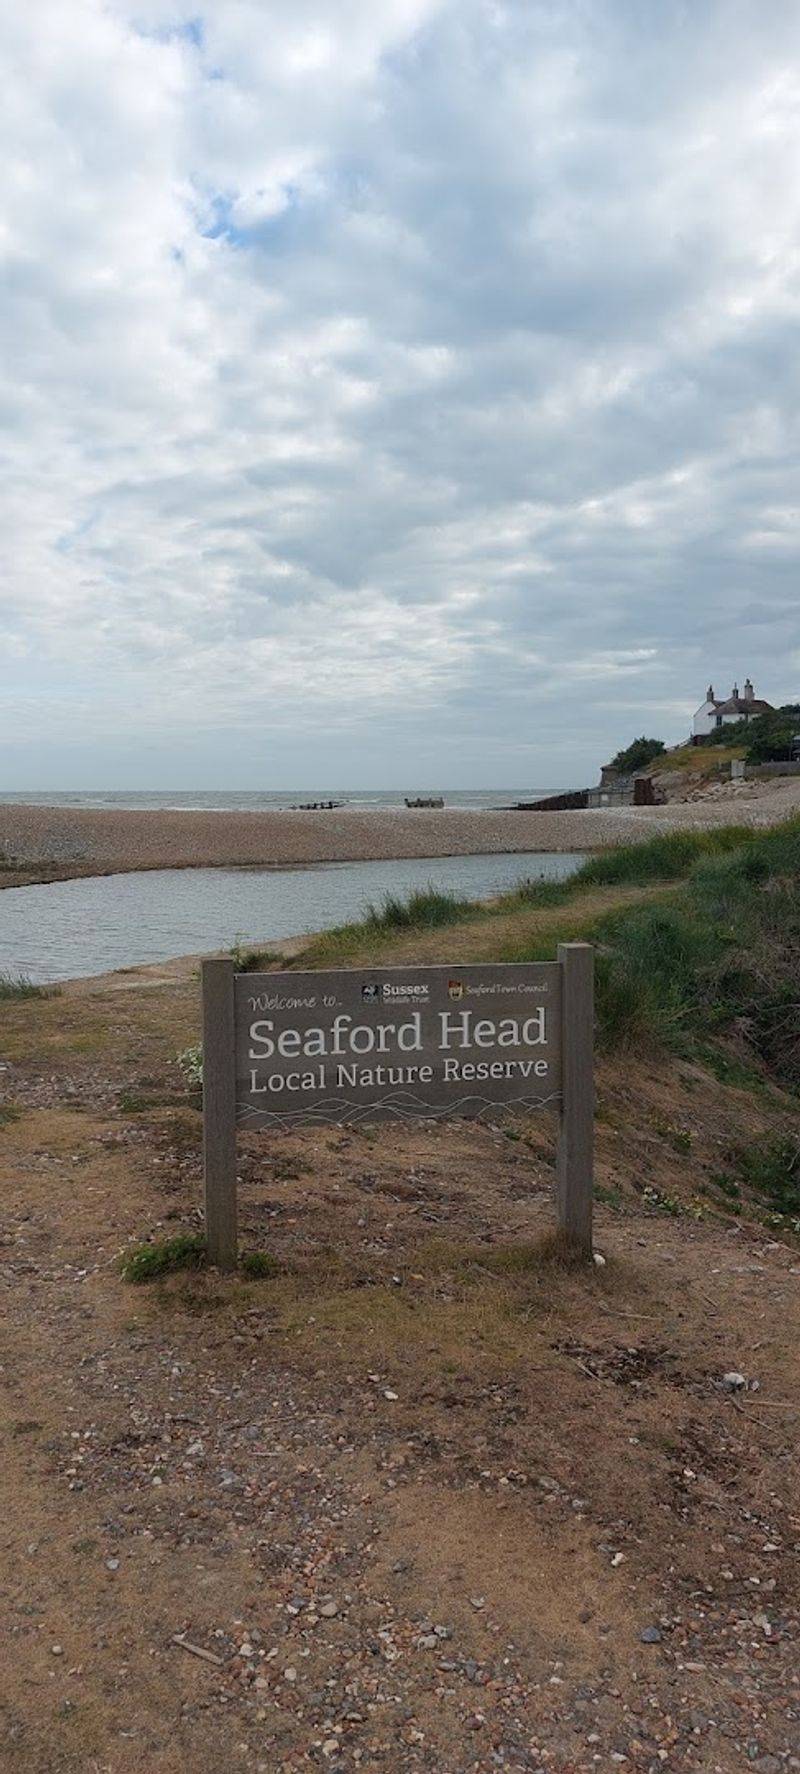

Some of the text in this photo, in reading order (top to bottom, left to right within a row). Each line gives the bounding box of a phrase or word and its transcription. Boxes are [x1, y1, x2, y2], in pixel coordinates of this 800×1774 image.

[248, 993, 316, 1011] Welcome
[382, 983, 429, 996] Sussex
[249, 1007, 548, 1059] Seaford Head
[249, 1058, 548, 1093] Local Nature Reserve
